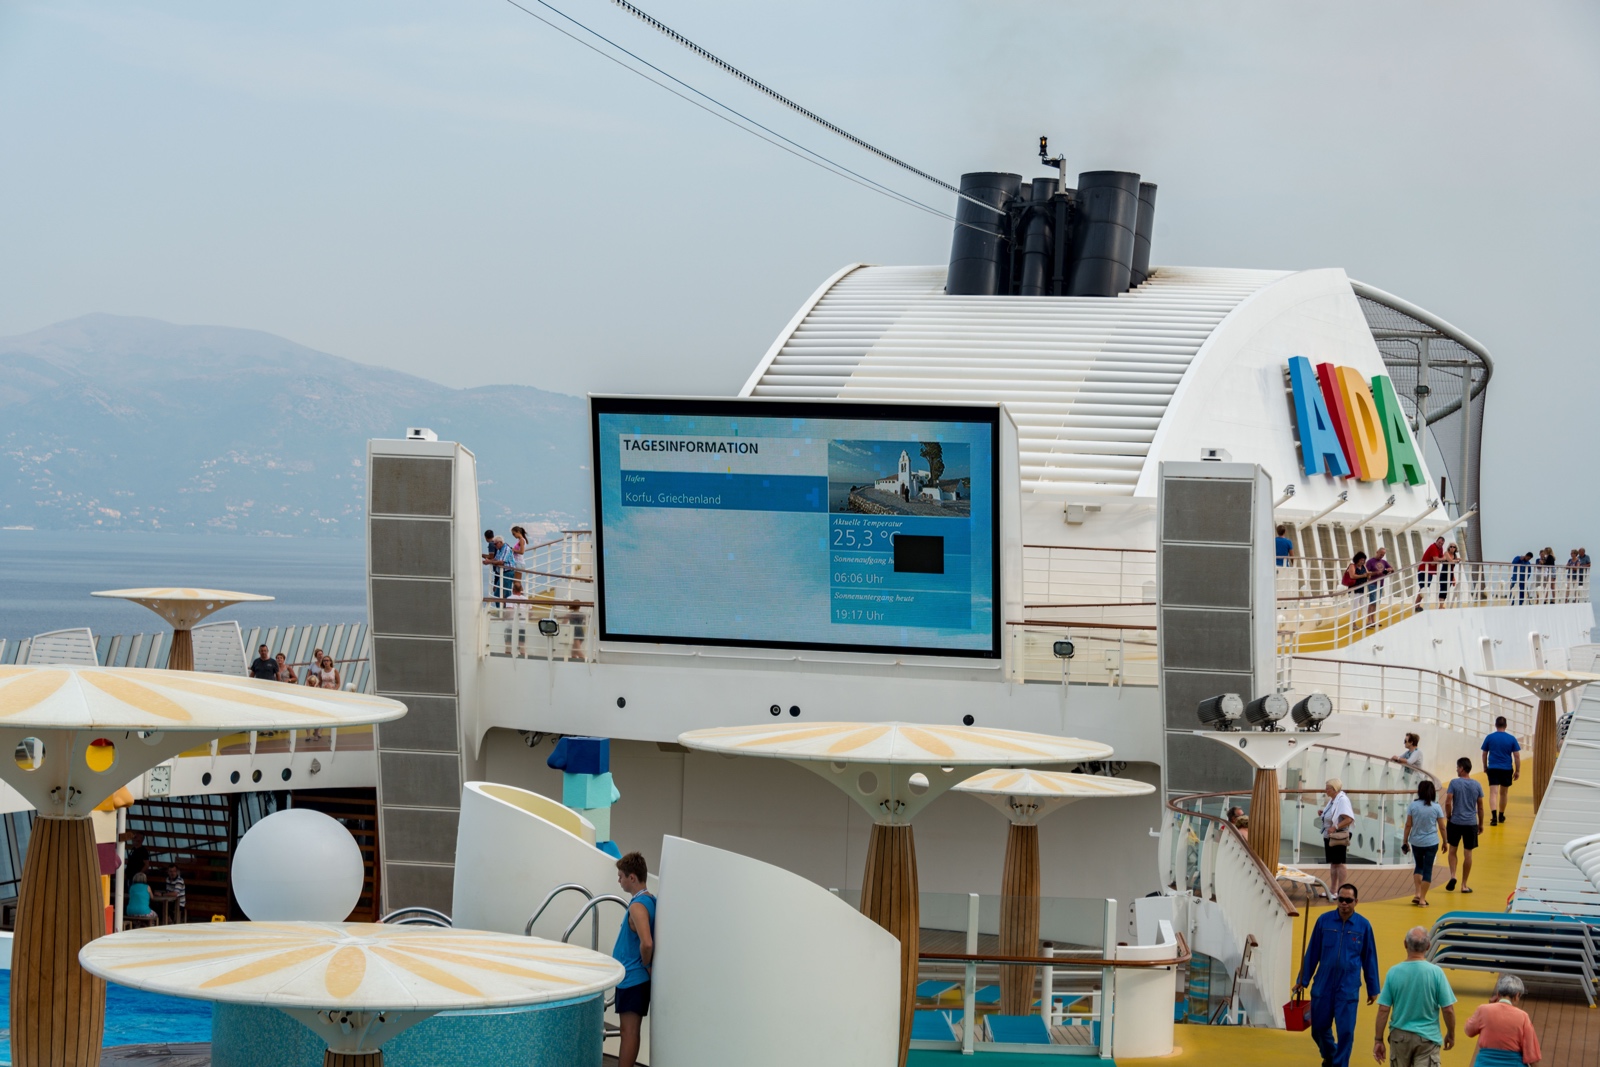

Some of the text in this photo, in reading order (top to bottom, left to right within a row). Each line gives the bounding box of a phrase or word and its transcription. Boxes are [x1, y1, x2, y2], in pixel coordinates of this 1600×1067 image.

[1288, 355, 1426, 487] AIDA
[623, 439, 759, 454] TAGESINFORMATION
[624, 474, 646, 483] Hafen
[625, 492, 721, 505] Korfu, Griechenland
[833, 518, 903, 529] Aktuelle Temperatur
[833, 529, 873, 549] 25,3
[833, 555, 887, 566] Sonnenaufgang
[834, 572, 884, 584] 06:06 Uhr
[834, 592, 915, 603] Sonnenuntergang heute
[835, 609, 884, 621] 19:17 Uhr
